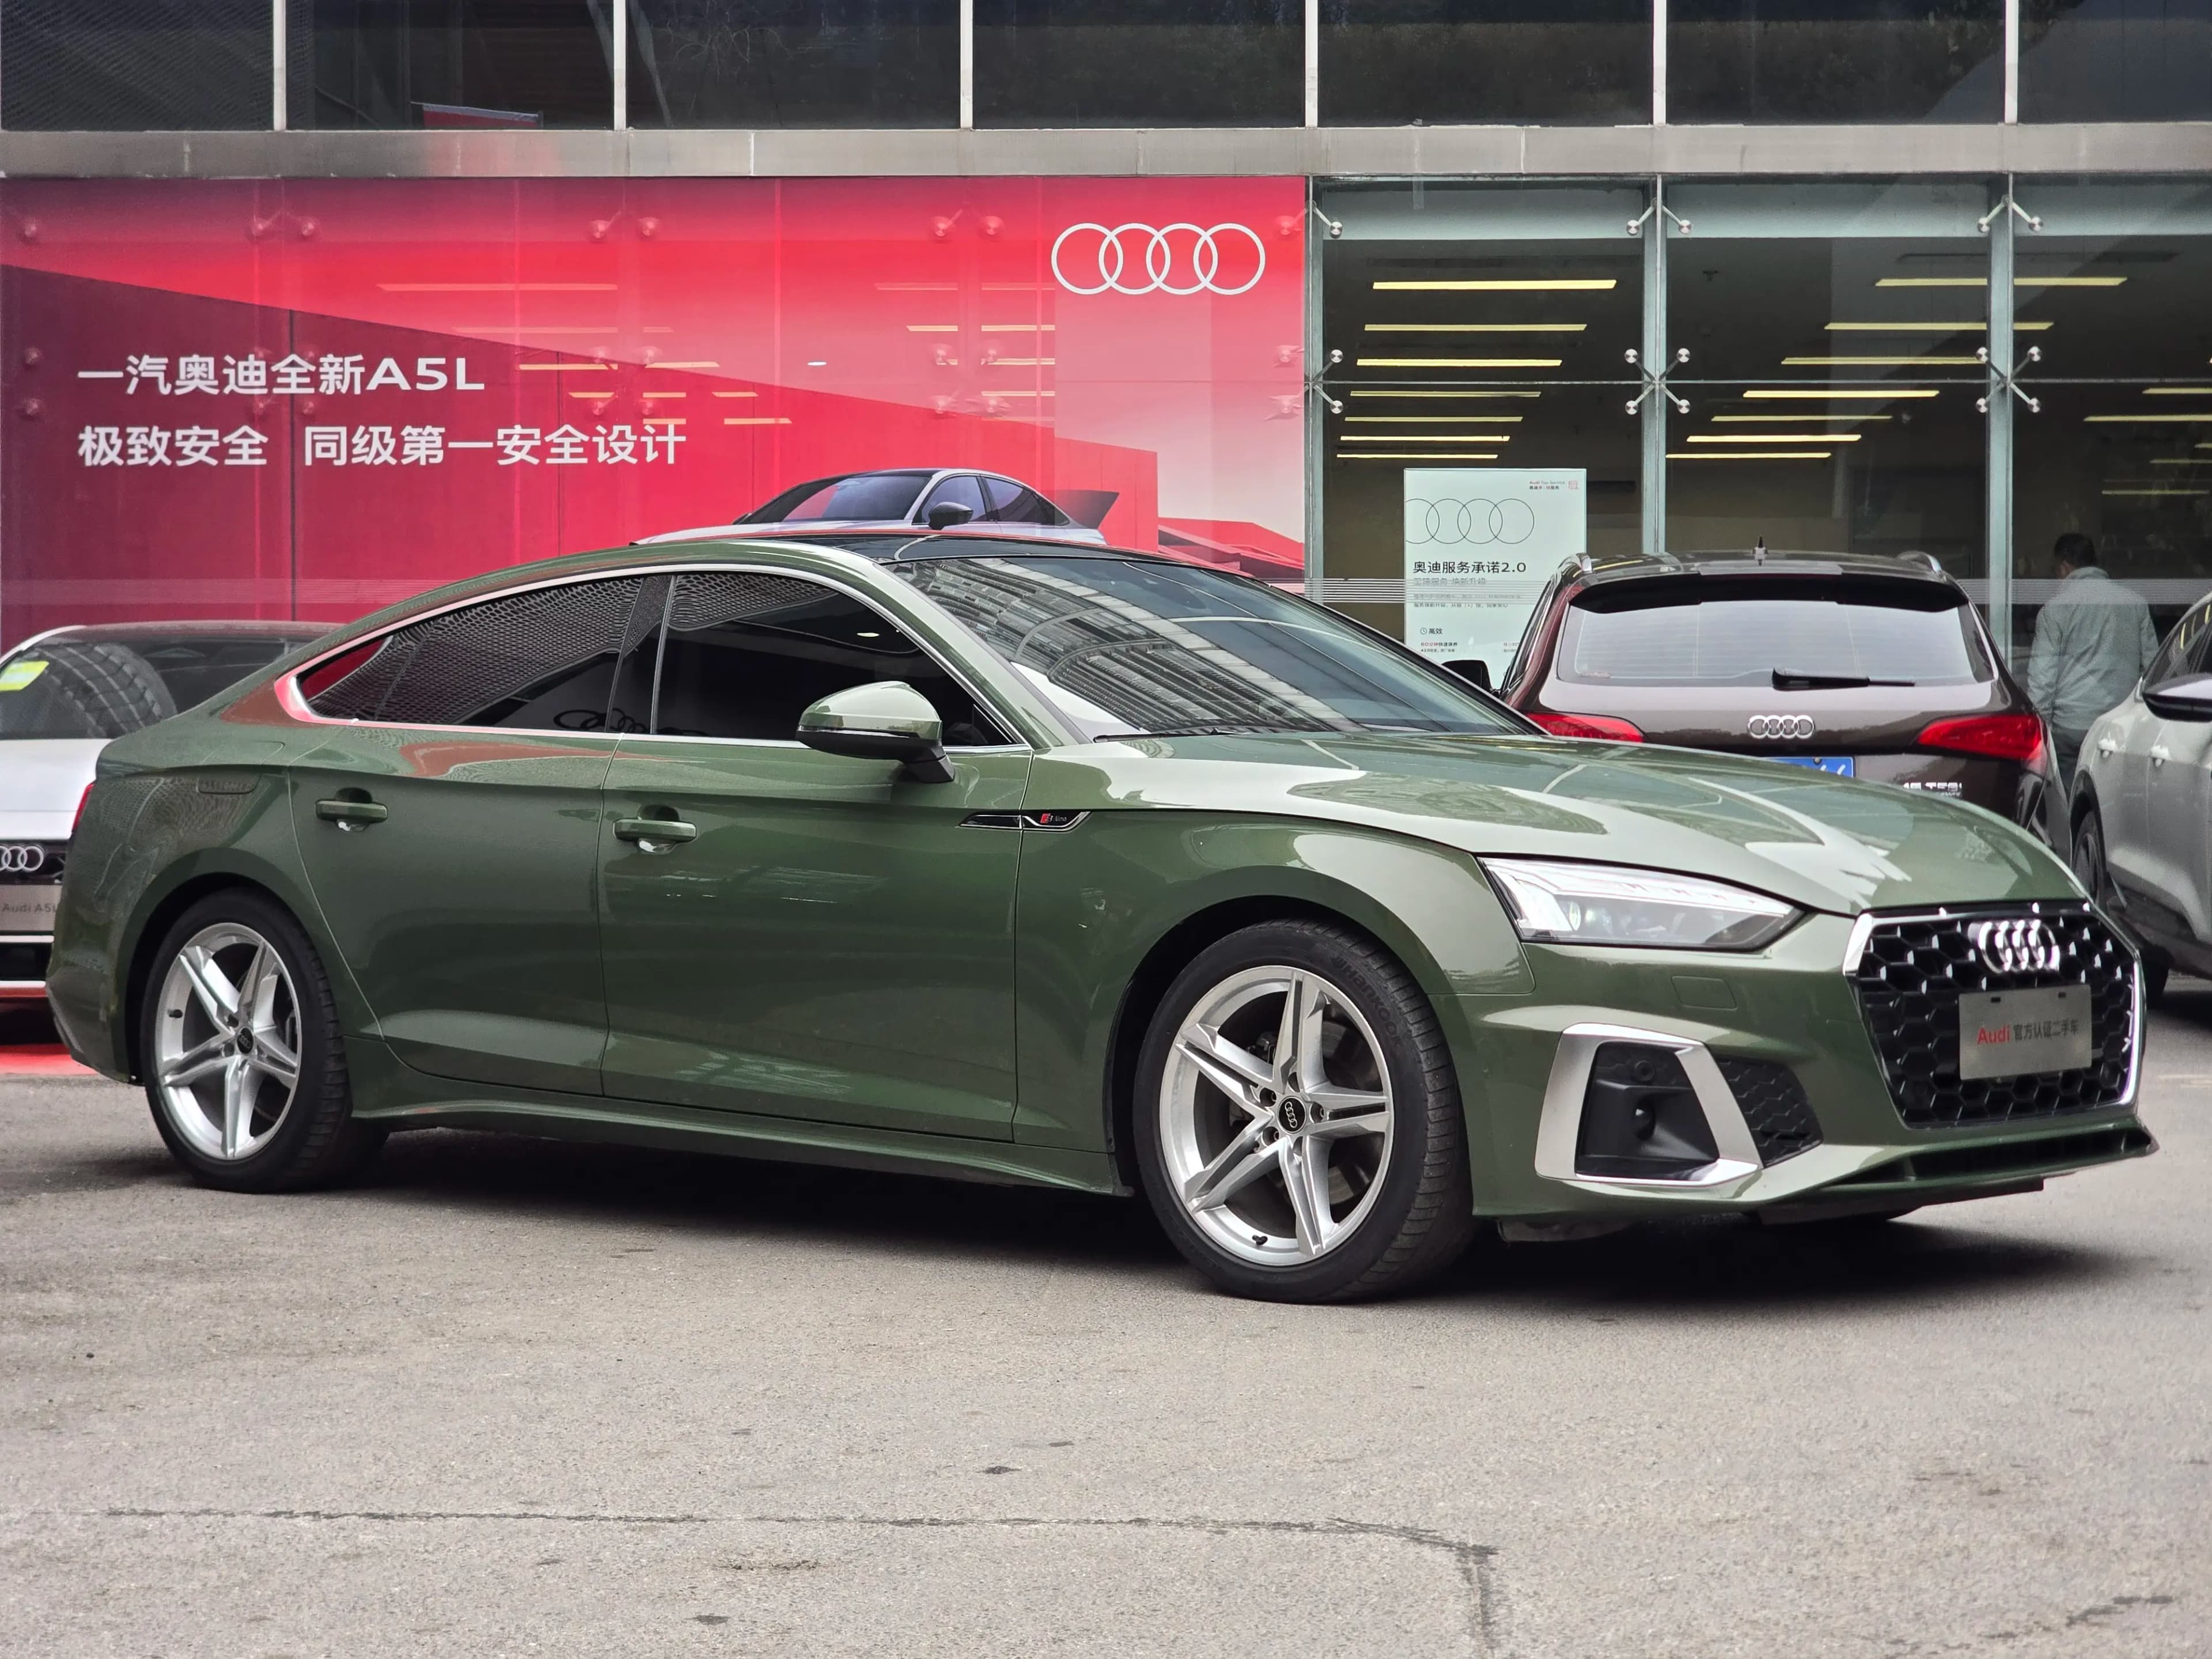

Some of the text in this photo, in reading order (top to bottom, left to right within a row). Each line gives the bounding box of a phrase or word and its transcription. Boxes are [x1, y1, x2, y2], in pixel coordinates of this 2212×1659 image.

[78, 354, 485, 395] 一汽奥迪全新A5L
[78, 424, 687, 466] 极致安全 同级第一安全设计
[1413, 561, 1527, 574] 奥迪服务承诺2.0
[1977, 1025, 2010, 1045] Audi
